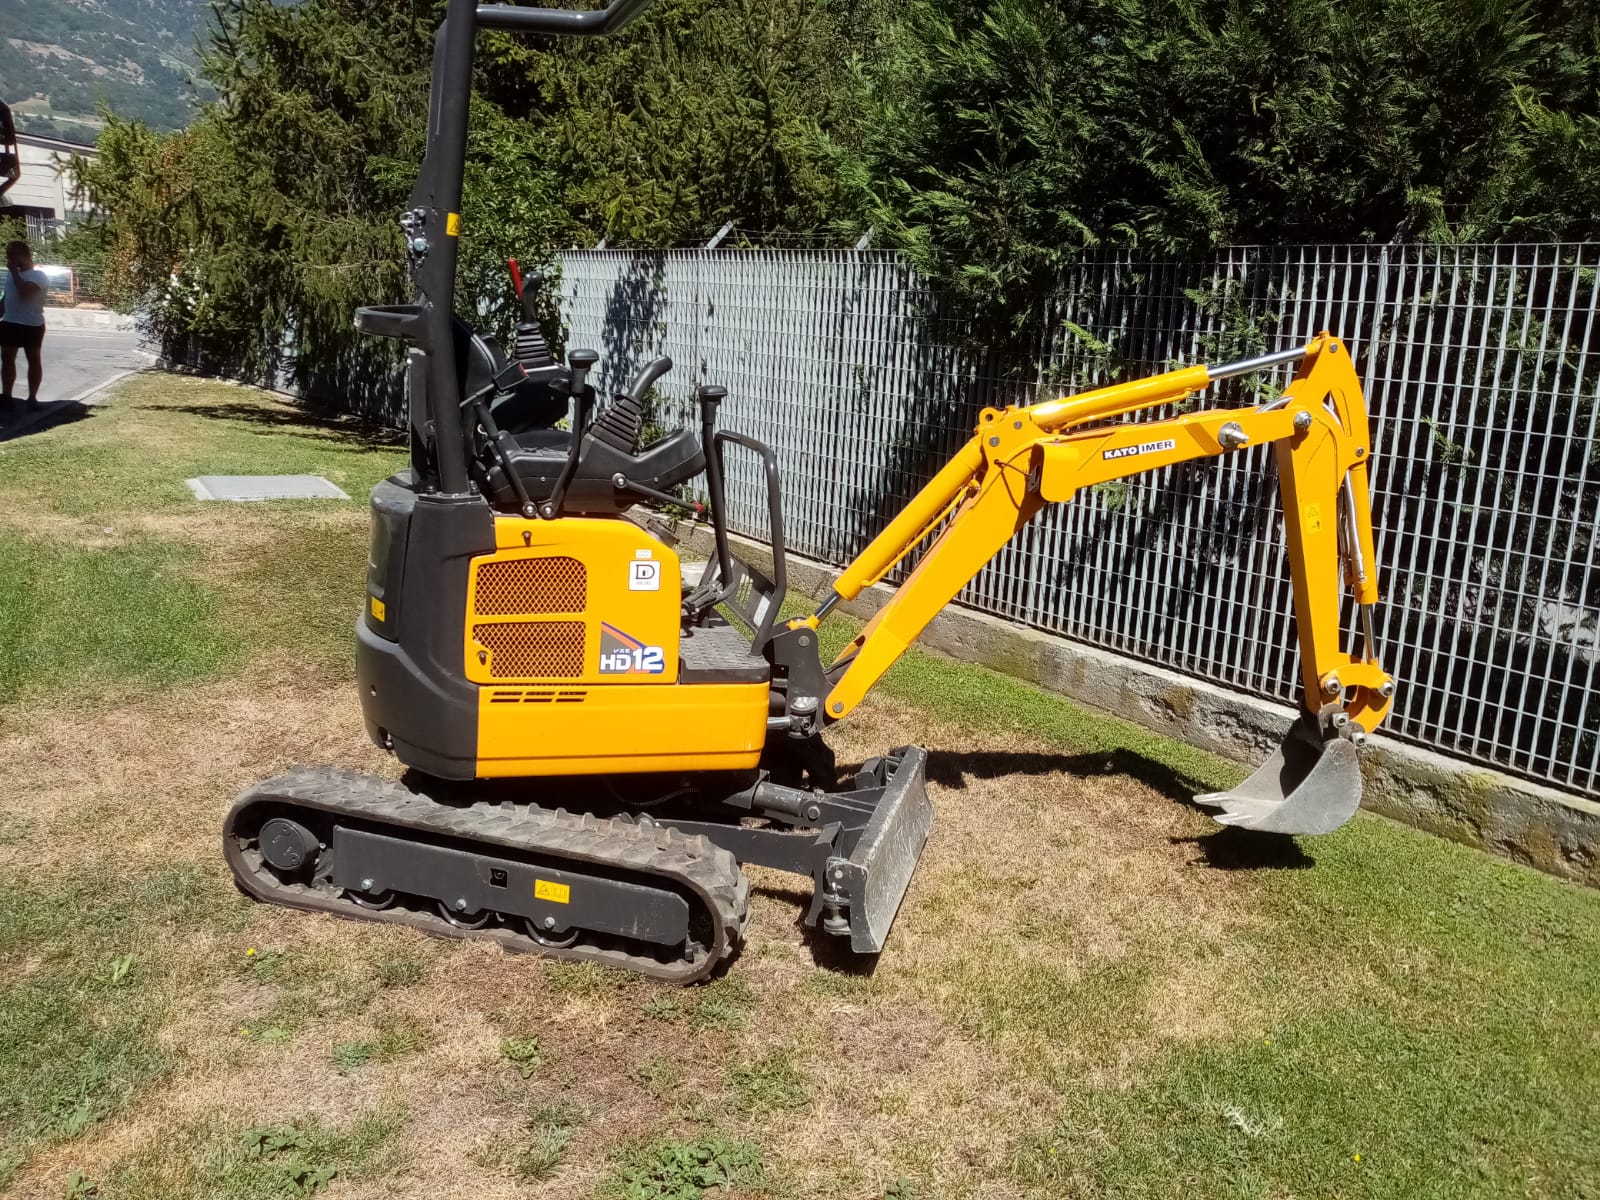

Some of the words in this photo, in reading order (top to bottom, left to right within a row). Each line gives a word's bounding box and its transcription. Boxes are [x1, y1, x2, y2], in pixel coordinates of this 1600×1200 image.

[1104, 446, 1138, 459] KATO
[1141, 440, 1173, 452] IMER
[600, 646, 664, 671] HD12
